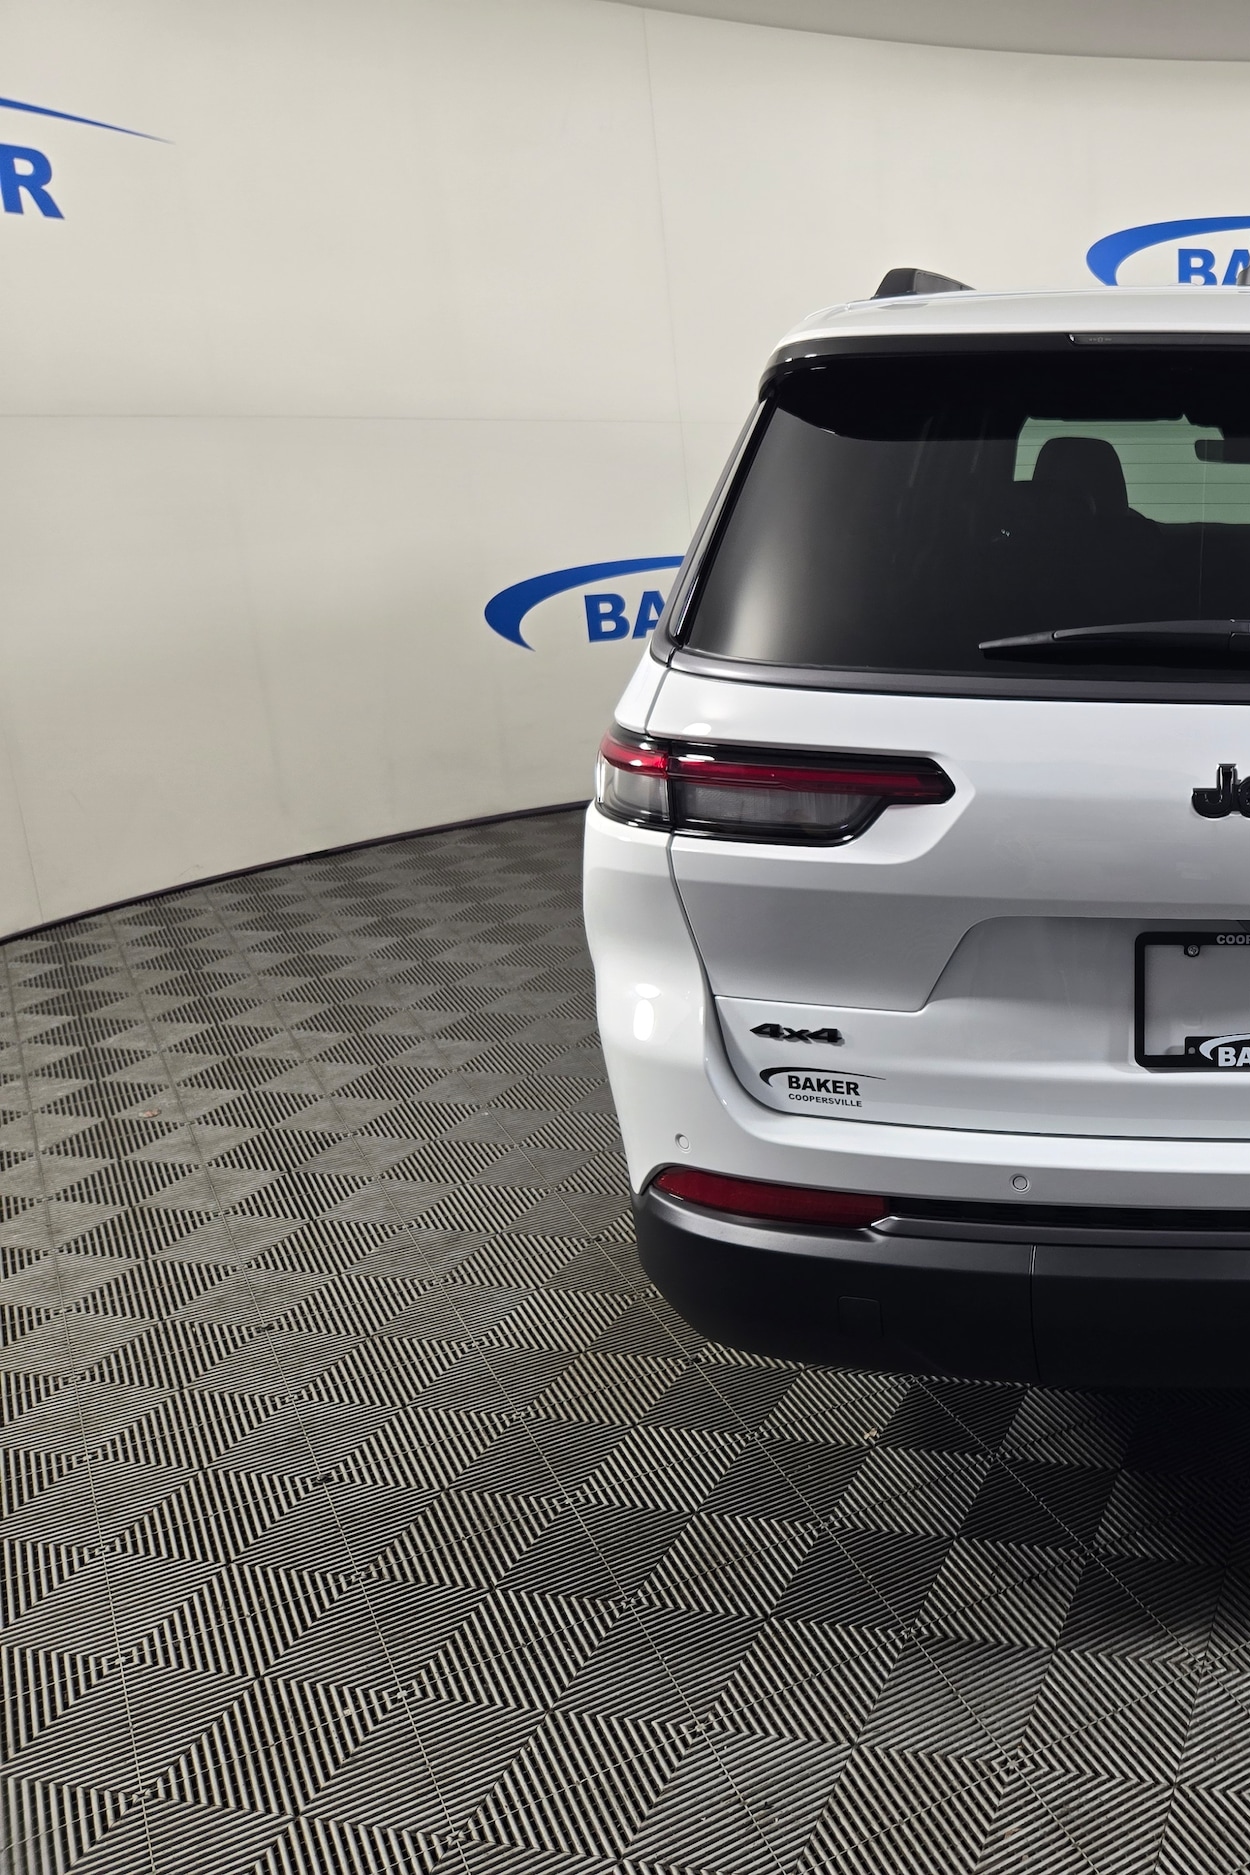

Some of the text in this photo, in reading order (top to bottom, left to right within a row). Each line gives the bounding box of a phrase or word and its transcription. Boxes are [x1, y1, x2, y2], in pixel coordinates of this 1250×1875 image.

[750, 1023, 844, 1046] 4x4
[787, 1074, 861, 1097] BAKER
[788, 1093, 863, 1108] COOPERSVILLE
